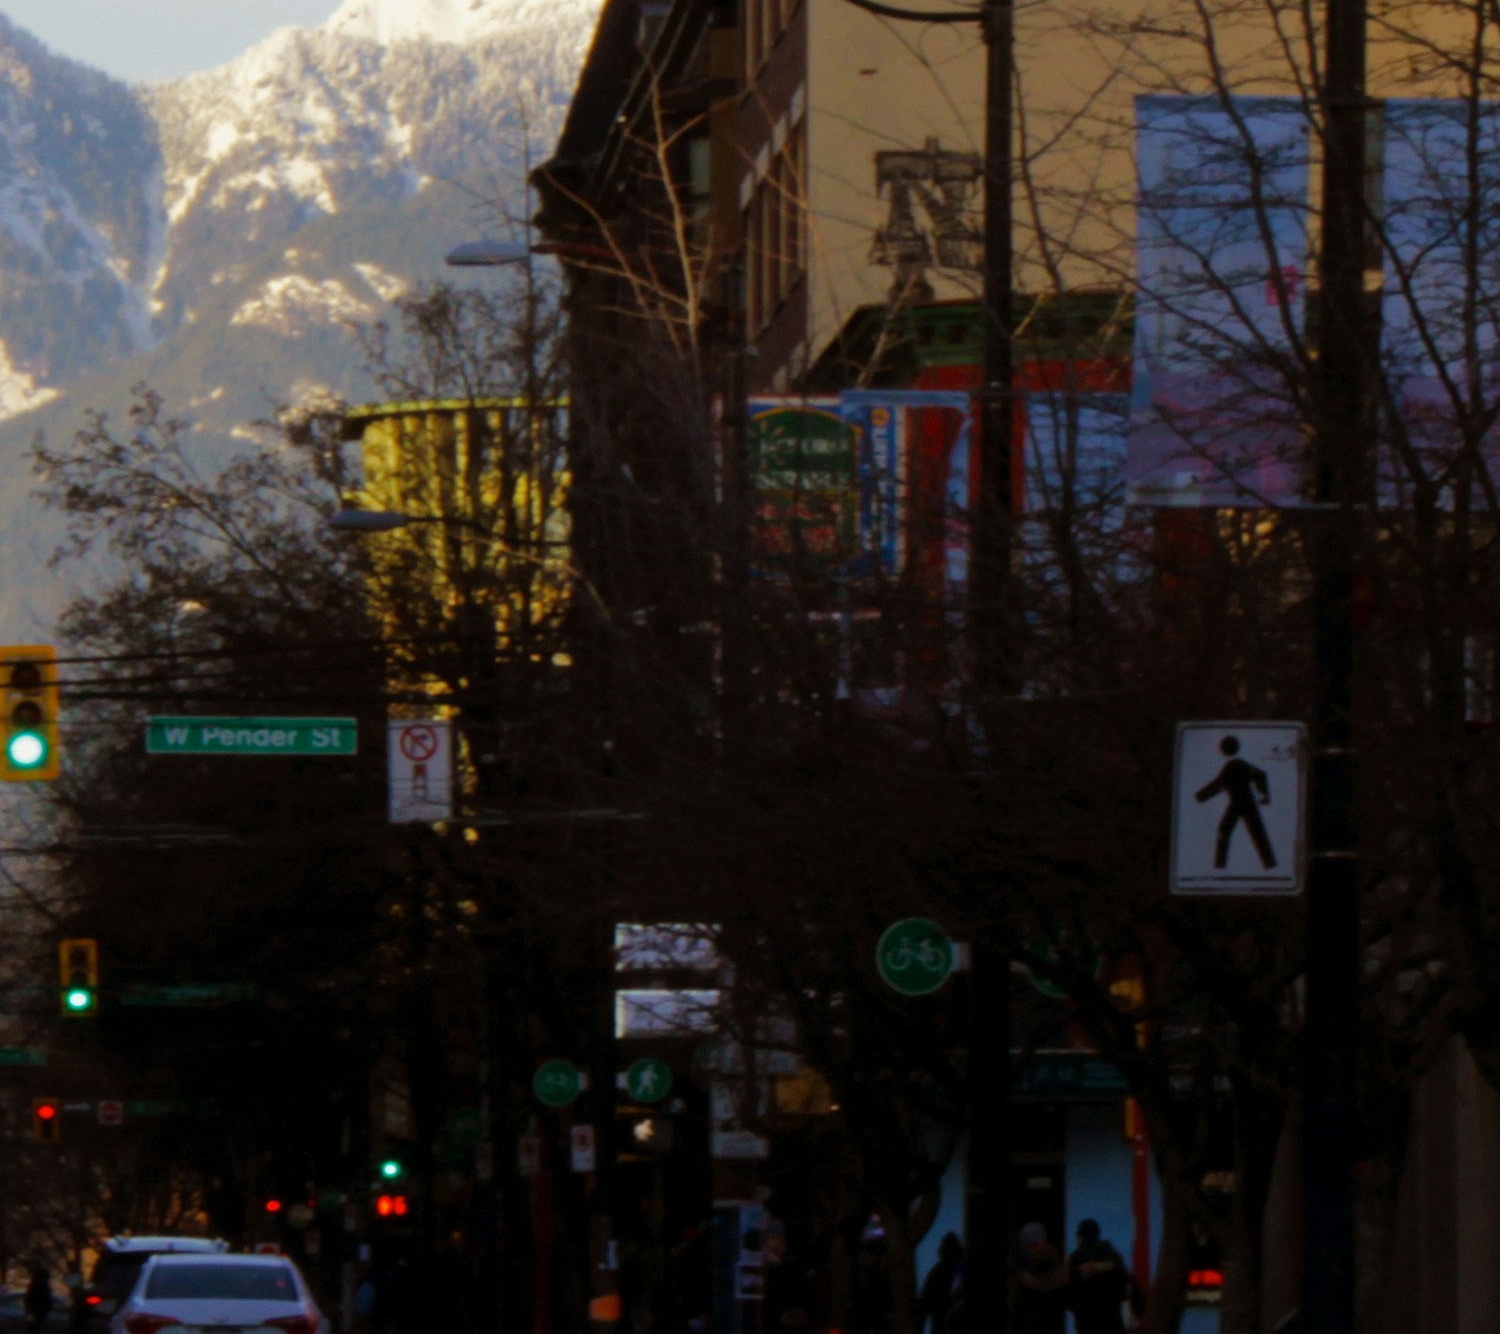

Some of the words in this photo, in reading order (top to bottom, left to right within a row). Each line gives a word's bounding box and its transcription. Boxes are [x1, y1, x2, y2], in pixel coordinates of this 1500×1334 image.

[163, 726, 190, 746] W
[202, 726, 299, 748] Pender
[311, 727, 341, 748] St
